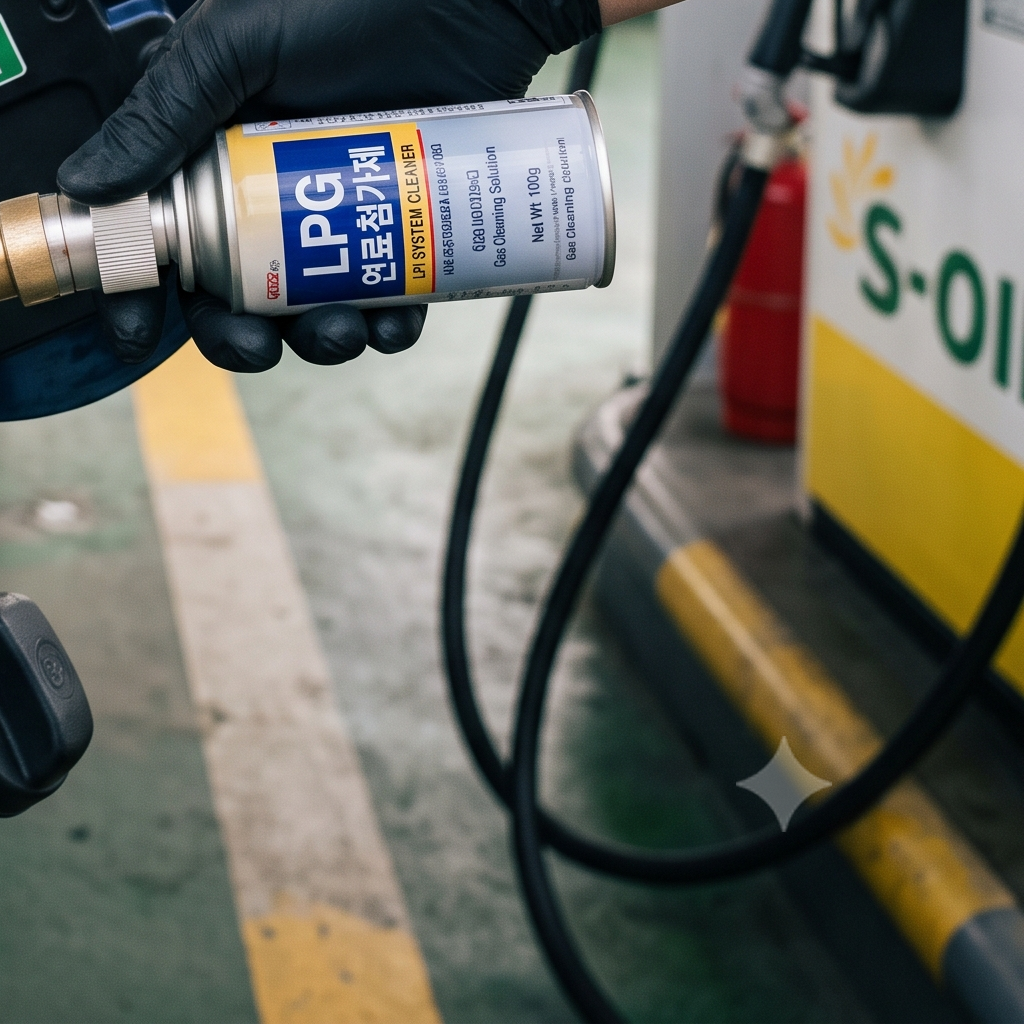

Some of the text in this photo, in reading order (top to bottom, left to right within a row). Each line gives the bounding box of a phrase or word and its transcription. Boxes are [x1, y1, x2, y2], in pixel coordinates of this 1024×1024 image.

[294, 172, 349, 278] LPG
[347, 145, 397, 286] 연료첨가제
[400, 144, 426, 279] LPI SYSTEM CLEANER
[527, 167, 541, 197] 100g
[529, 201, 543, 220] Wt
[859, 199, 1024, 404] S-OI
